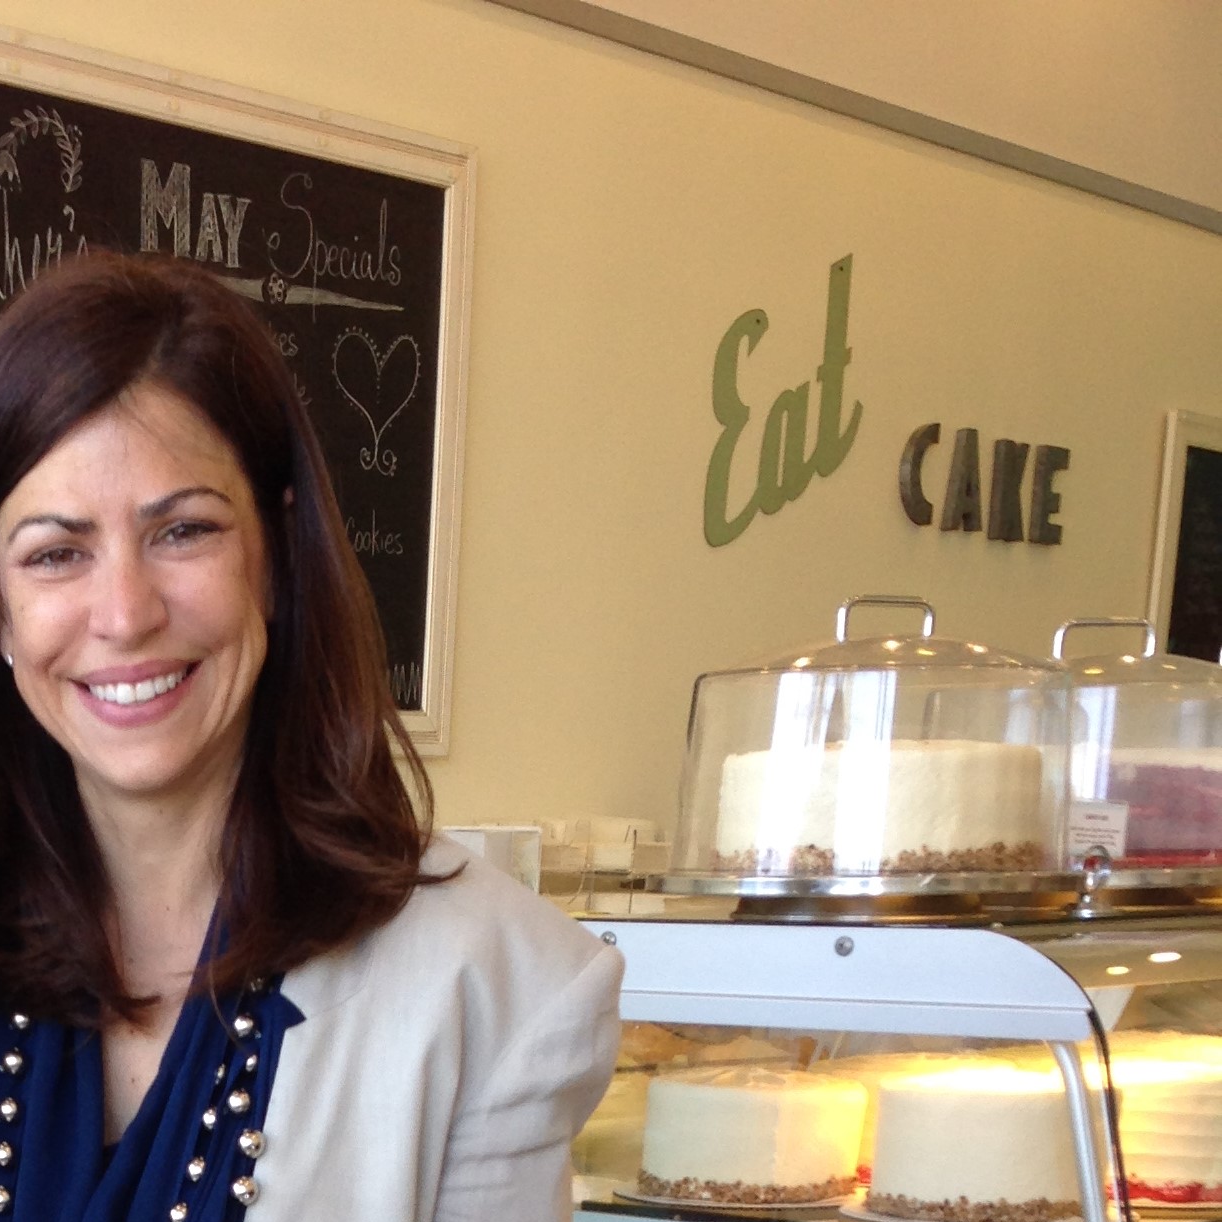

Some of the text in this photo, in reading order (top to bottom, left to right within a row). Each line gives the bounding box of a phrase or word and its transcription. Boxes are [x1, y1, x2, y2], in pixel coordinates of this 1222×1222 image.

[264, 172, 402, 324] Specials
[704, 252, 1071, 547] Eat CAKE
